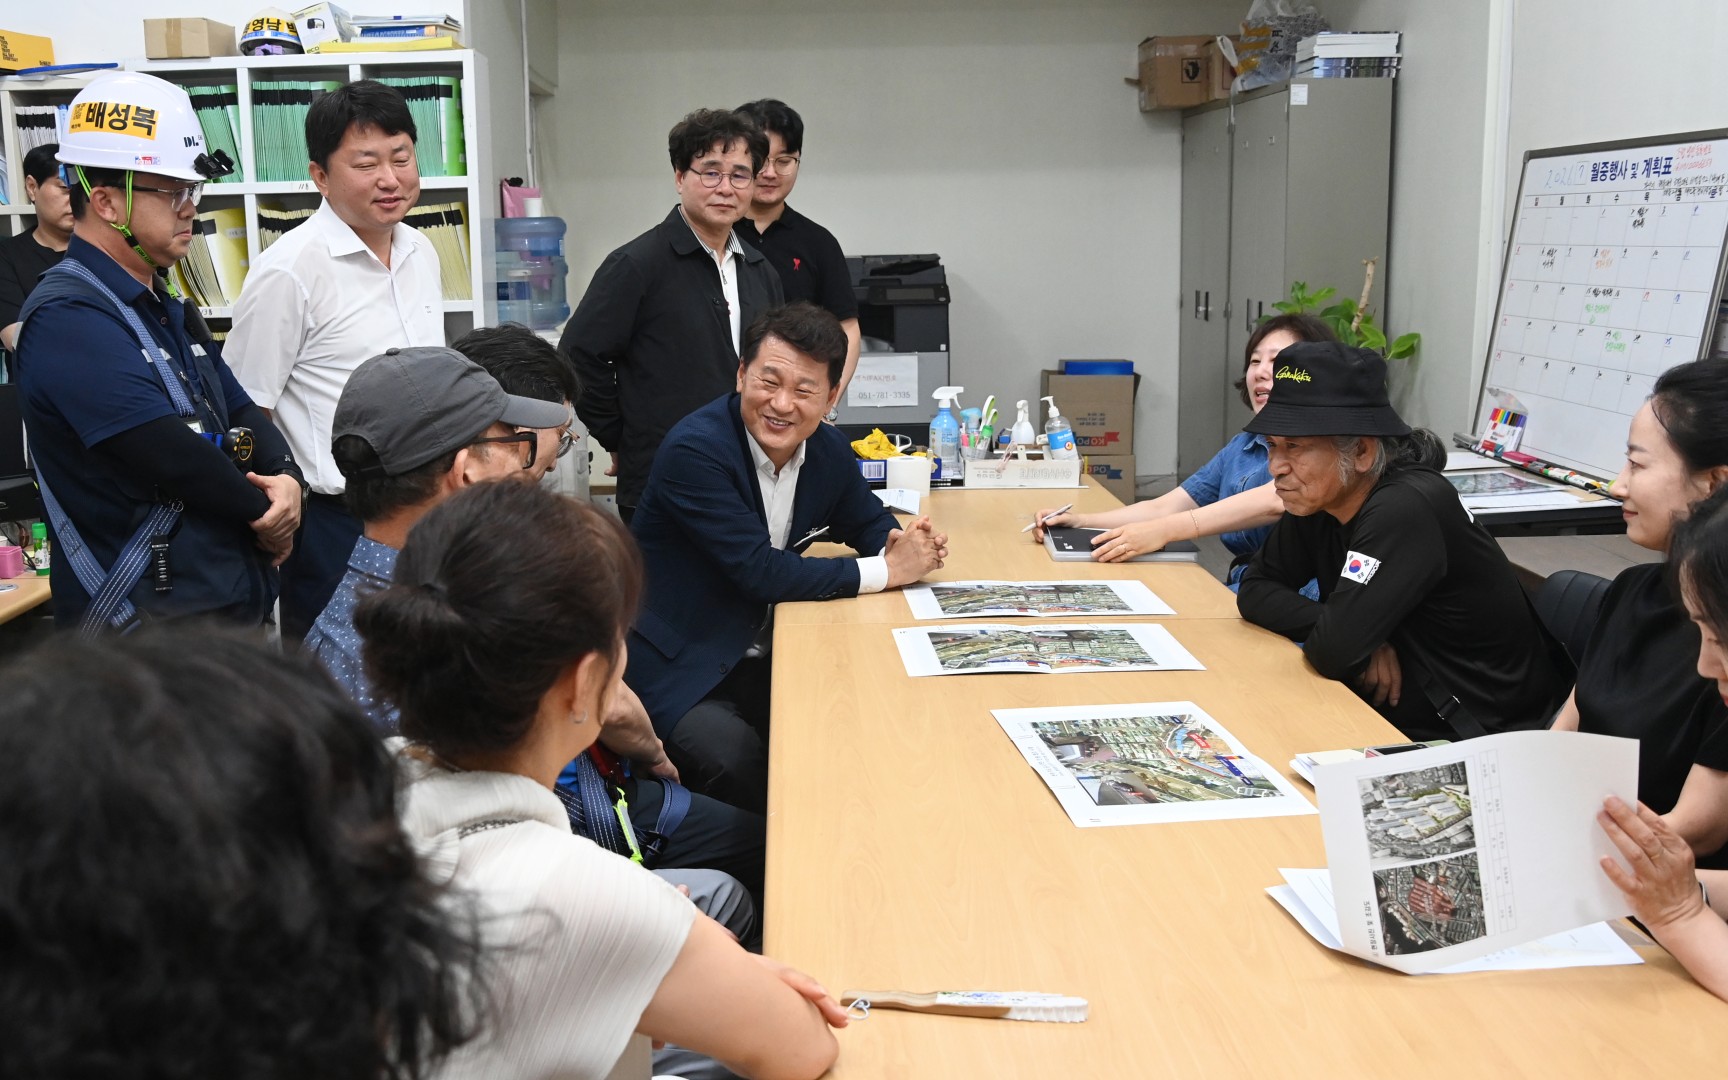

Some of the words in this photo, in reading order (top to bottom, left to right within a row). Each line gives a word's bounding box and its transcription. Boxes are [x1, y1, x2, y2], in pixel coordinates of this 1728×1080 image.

[85, 101, 156, 136] 배성복
[1590, 160, 1628, 182] 월중행사
[1630, 162, 1640, 179] 및
[1641, 157, 1673, 178] 계획표
[1076, 437, 1105, 446] KOPO
